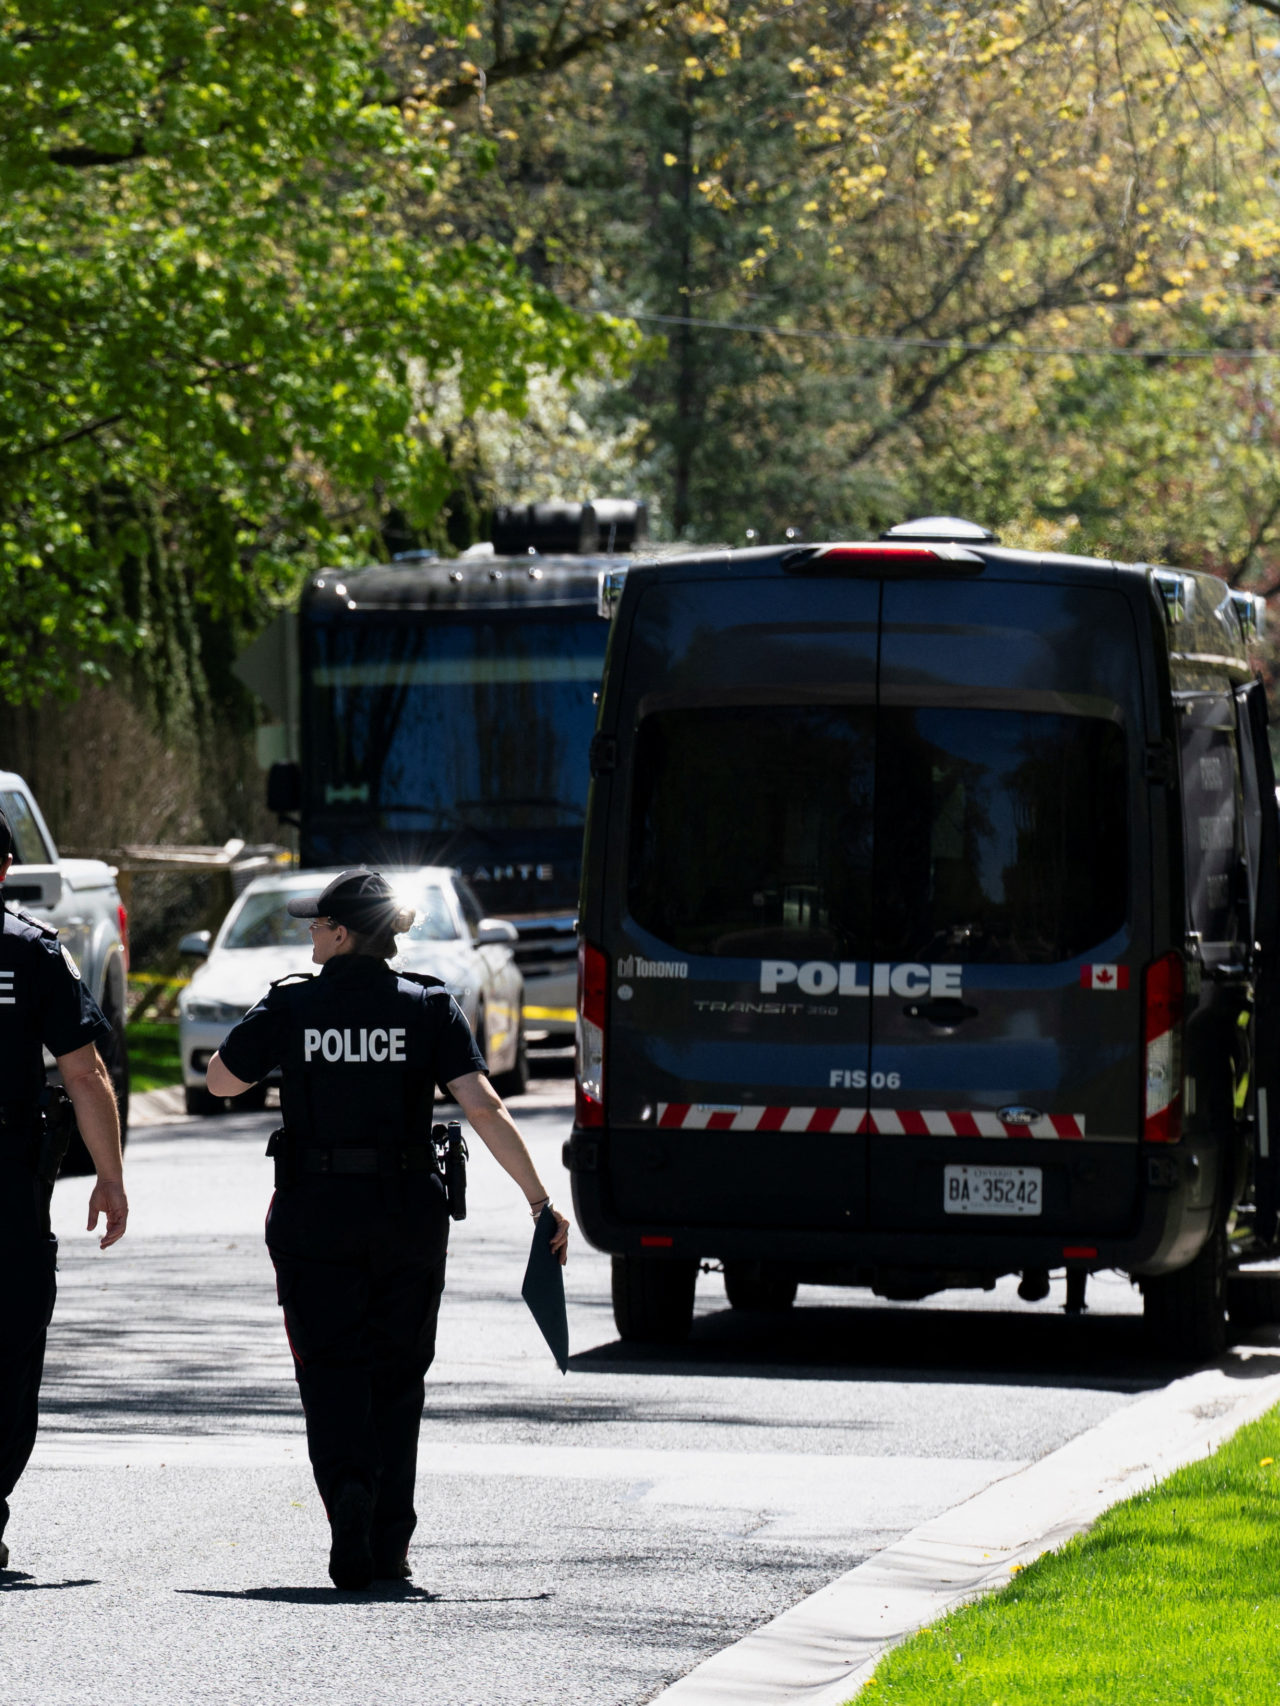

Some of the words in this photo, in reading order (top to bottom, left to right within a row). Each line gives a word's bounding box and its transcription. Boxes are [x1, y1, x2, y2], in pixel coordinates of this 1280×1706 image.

[635, 956, 688, 979] TORONTO
[760, 960, 963, 998] POLICE
[693, 1000, 804, 1015] TRANSIT
[807, 1006, 838, 1016] 350
[304, 1028, 407, 1062] POLICE
[829, 1070, 867, 1088] FIS
[871, 1072, 901, 1089] 06
